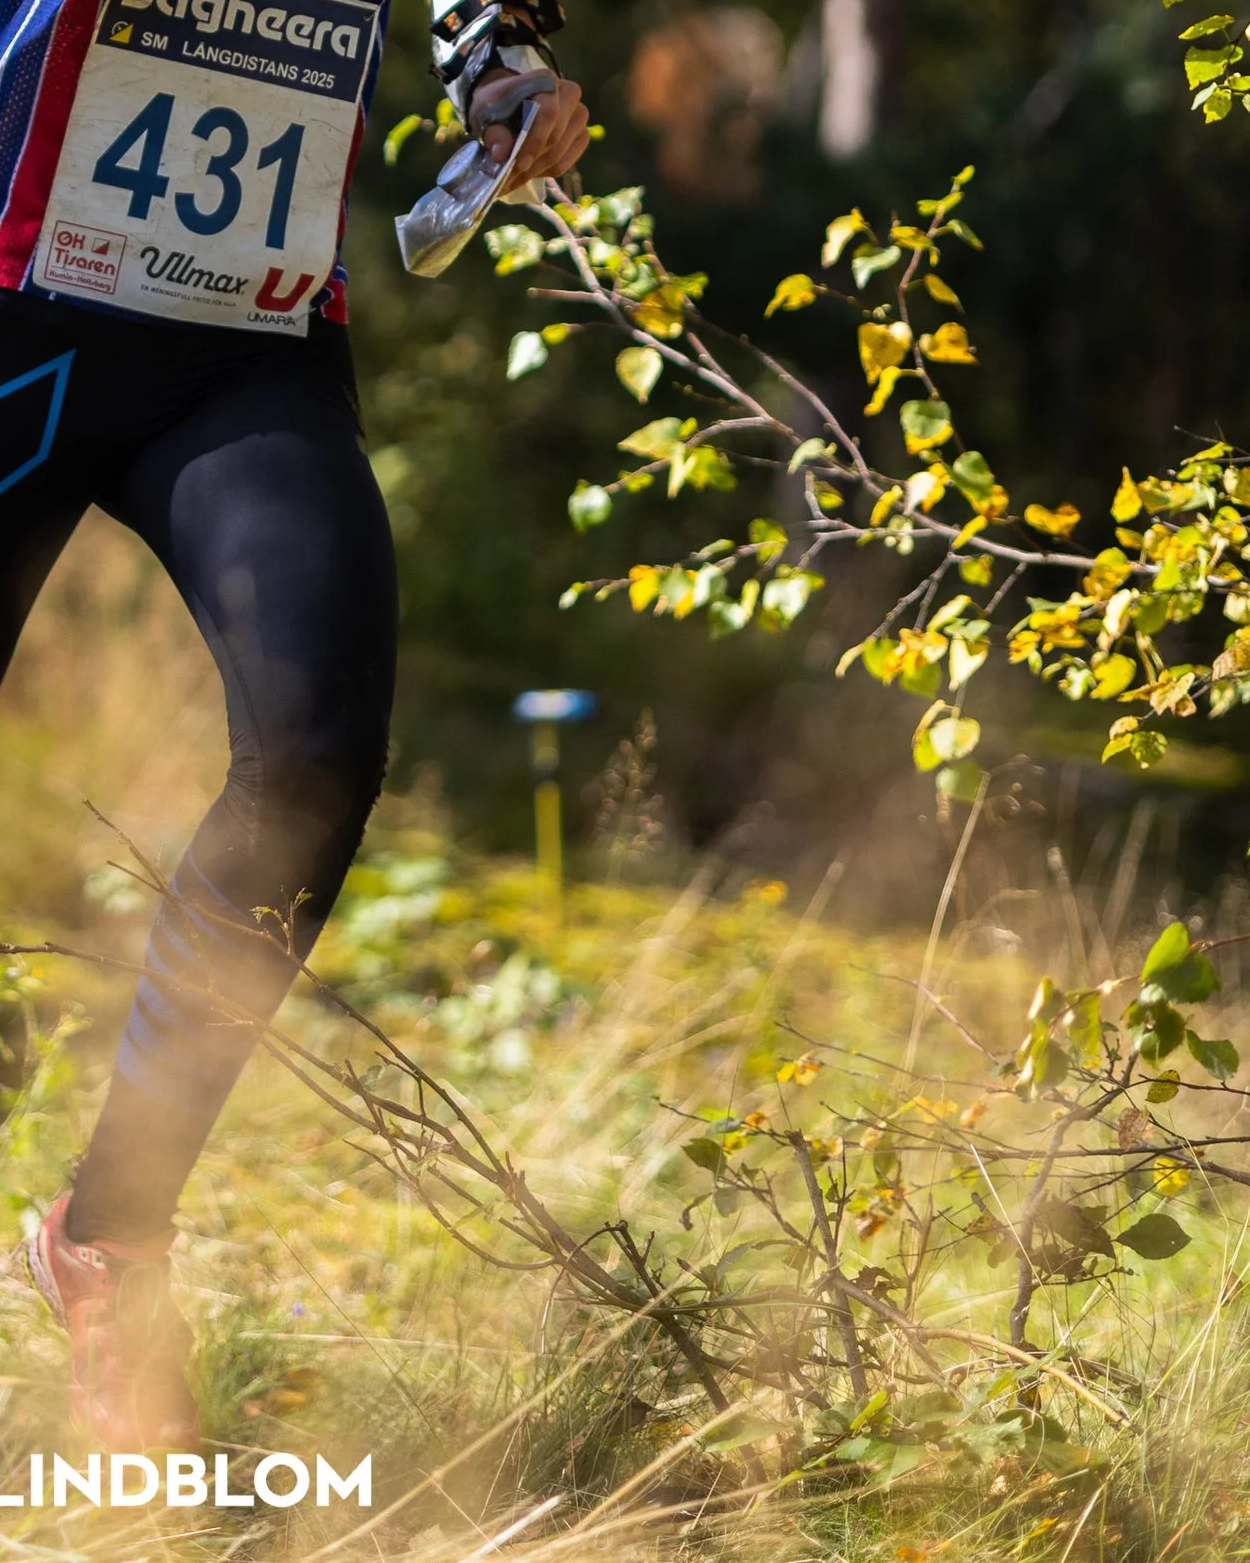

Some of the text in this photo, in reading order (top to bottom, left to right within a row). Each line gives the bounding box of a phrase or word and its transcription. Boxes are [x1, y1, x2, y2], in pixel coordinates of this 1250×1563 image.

[141, 31, 336, 89] SM LÅNGDISTANS 2025
[91, 91, 306, 251] 431
[54, 247, 116, 276] Tisaren
[140, 246, 249, 295] Ullmax
[247, 311, 296, 327] UMARA
